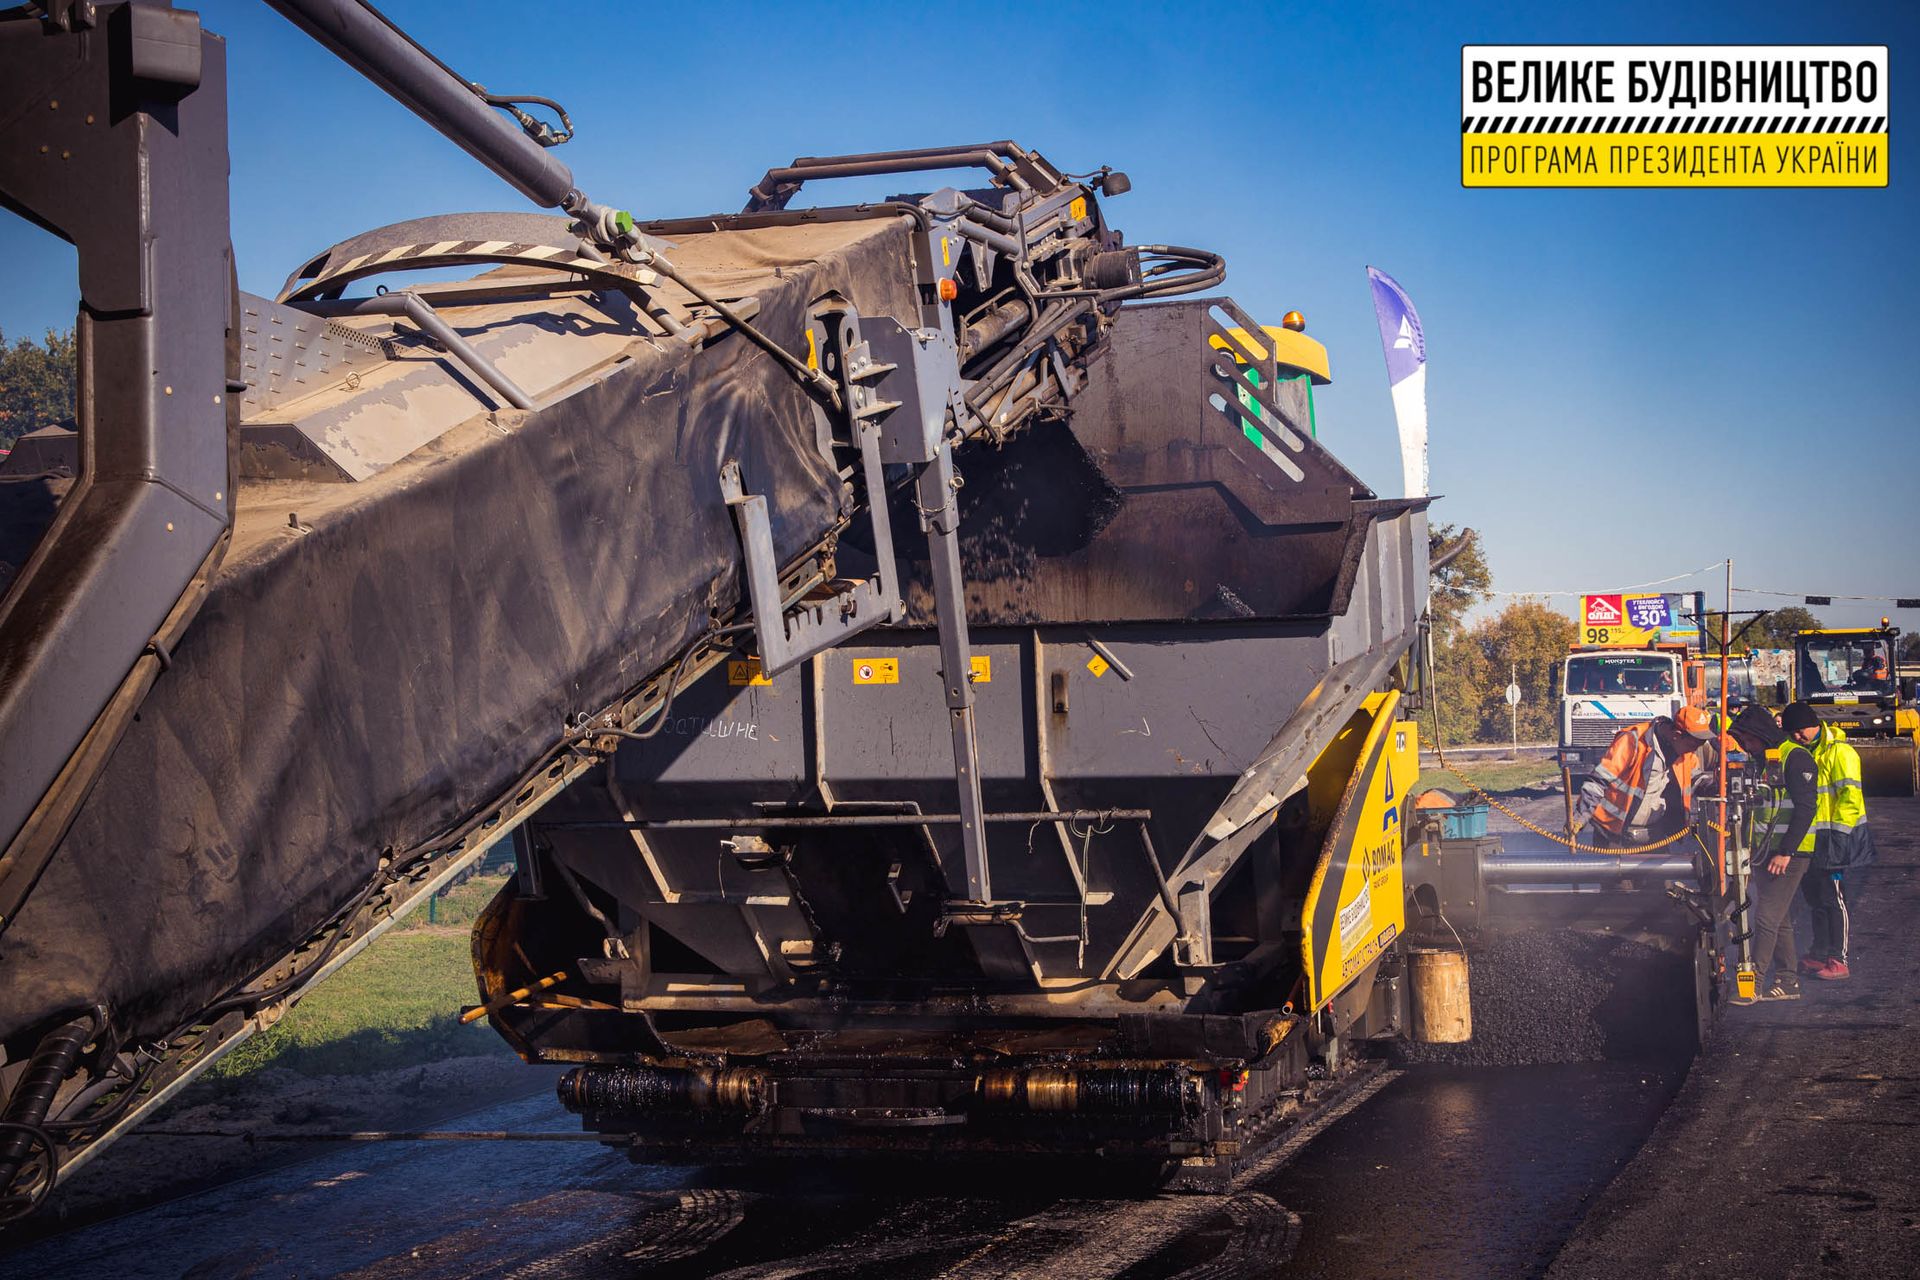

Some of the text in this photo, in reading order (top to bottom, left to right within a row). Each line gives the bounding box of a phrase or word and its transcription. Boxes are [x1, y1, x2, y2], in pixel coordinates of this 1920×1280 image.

[1639, 609, 1667, 626] 30%
[1586, 628, 1609, 644] 98
[1372, 839, 1395, 876] BOMAG
